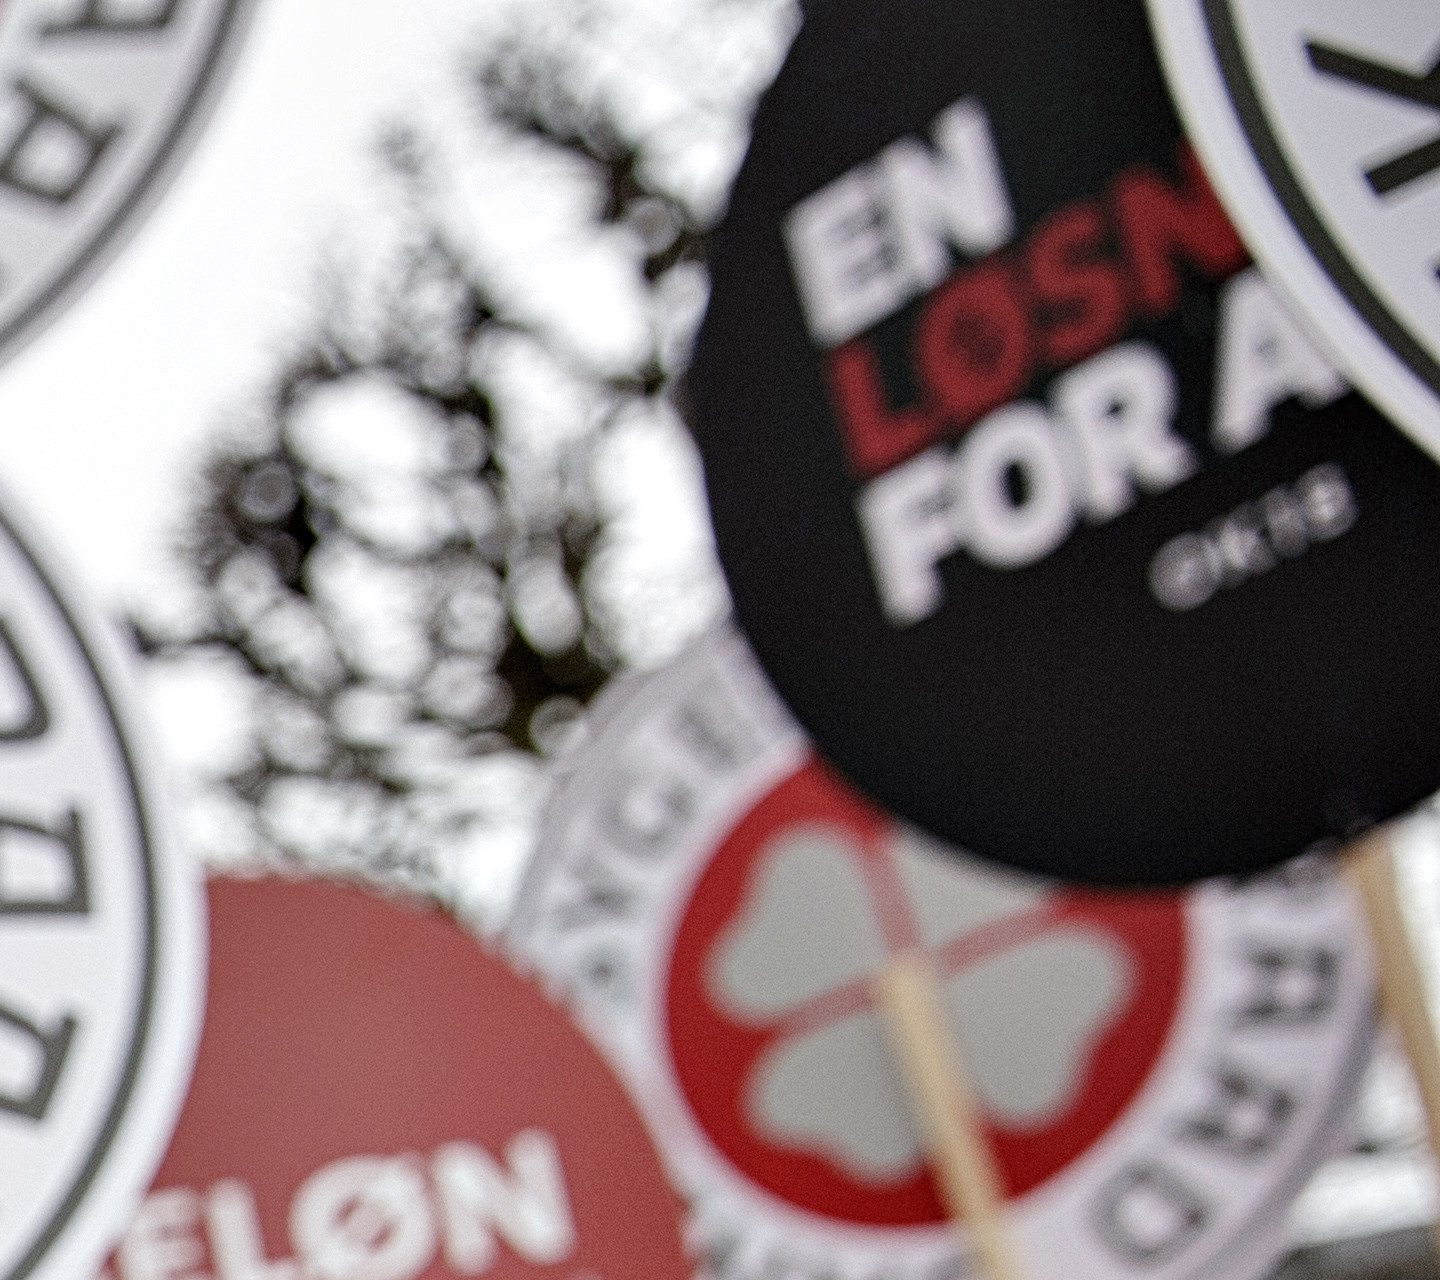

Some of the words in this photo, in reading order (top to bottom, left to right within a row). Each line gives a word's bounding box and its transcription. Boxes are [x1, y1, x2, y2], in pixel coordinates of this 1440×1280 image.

[787, 95, 1013, 350] EN
[825, 140, 1259, 481] LØSN
[858, 338, 1197, 628] FOR
